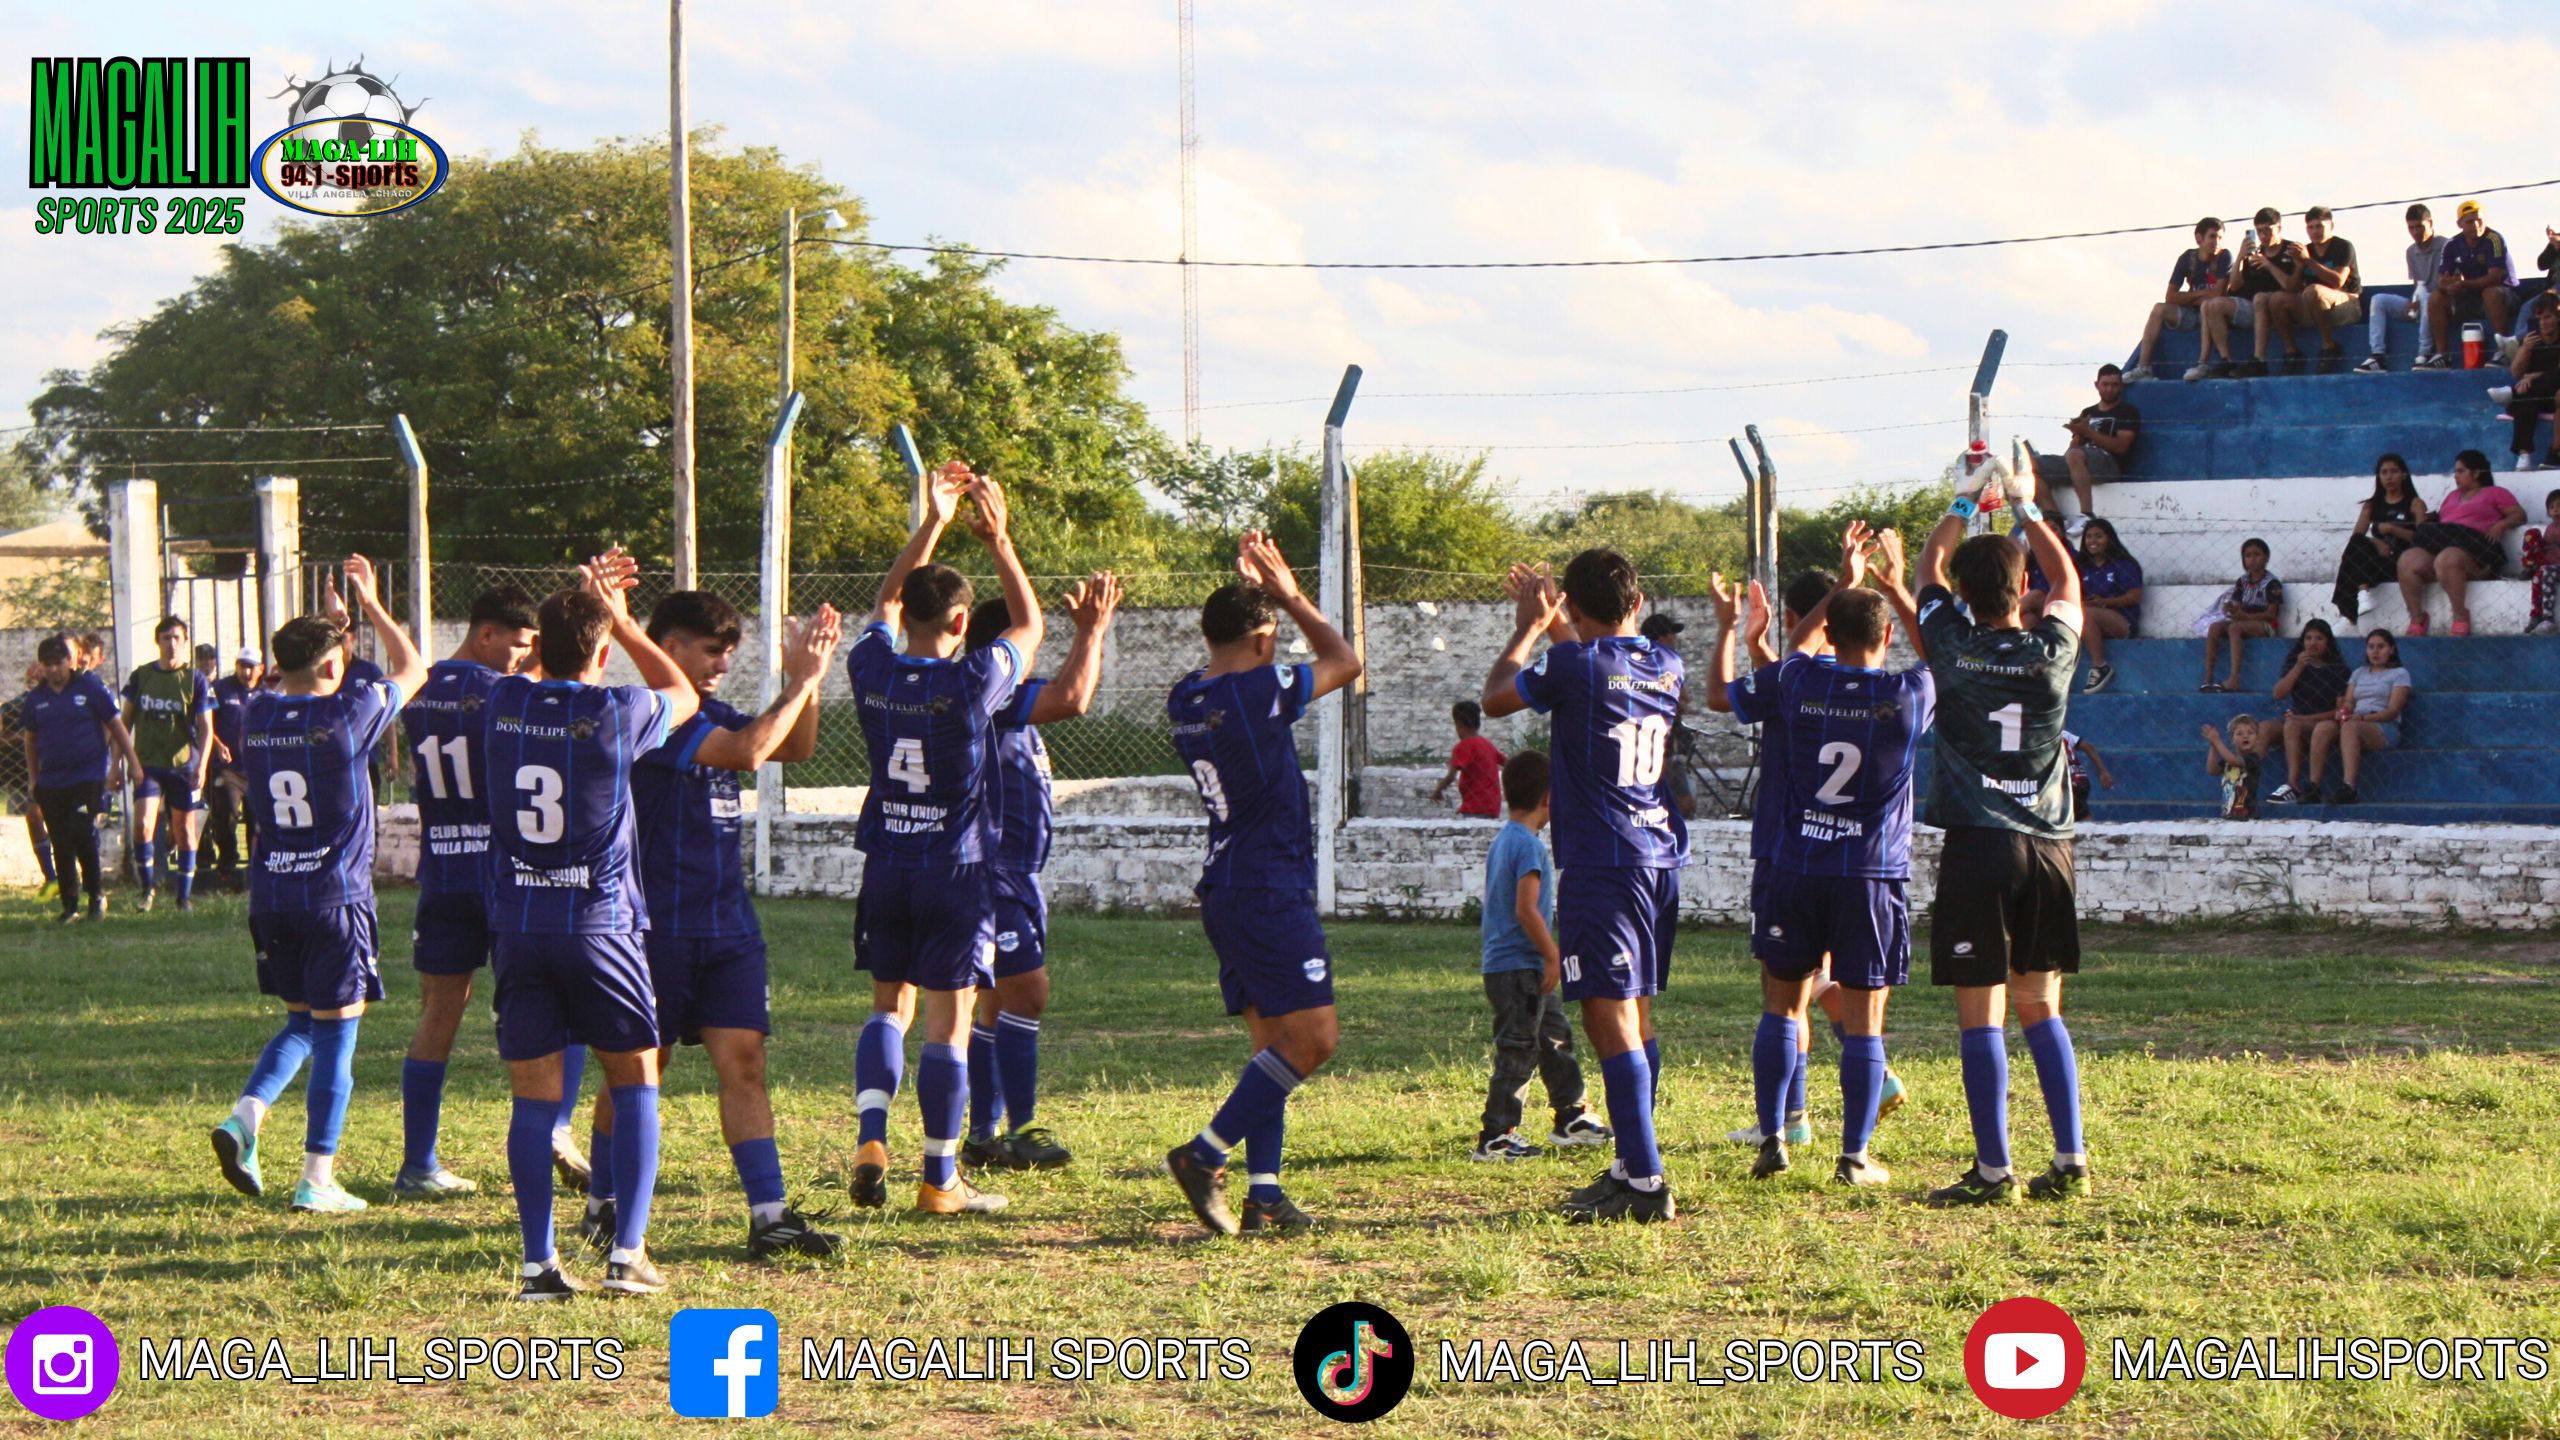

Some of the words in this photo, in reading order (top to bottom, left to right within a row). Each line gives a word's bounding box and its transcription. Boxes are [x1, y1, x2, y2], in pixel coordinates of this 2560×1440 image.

[1956, 658, 1983, 671] DON
[1986, 665, 2025, 675] FELIPE
[865, 696, 888, 710] DON
[1800, 704, 1826, 715] DON
[1829, 708, 1870, 717] FELIPE
[496, 721, 522, 733] DON
[525, 725, 568, 736] FELIPE
[1988, 703, 2023, 752] 1
[247, 738, 269, 747] DON
[1608, 714, 1672, 788] 10
[417, 735, 474, 799] 11
[887, 738, 931, 793] 4
[1815, 742, 1862, 805] 2
[1192, 759, 1228, 822] 9
[268, 770, 312, 829] 8
[515, 764, 564, 844] 3
[882, 801, 908, 817] CLUB
[1804, 809, 1835, 825] CLUB
[430, 825, 459, 839] CLUB
[885, 818, 911, 833] VILLA
[1801, 823, 1834, 841] VILLA
[431, 841, 461, 855] VILLA
[515, 873, 551, 887] VILLA
[1563, 955, 1581, 983] 10
